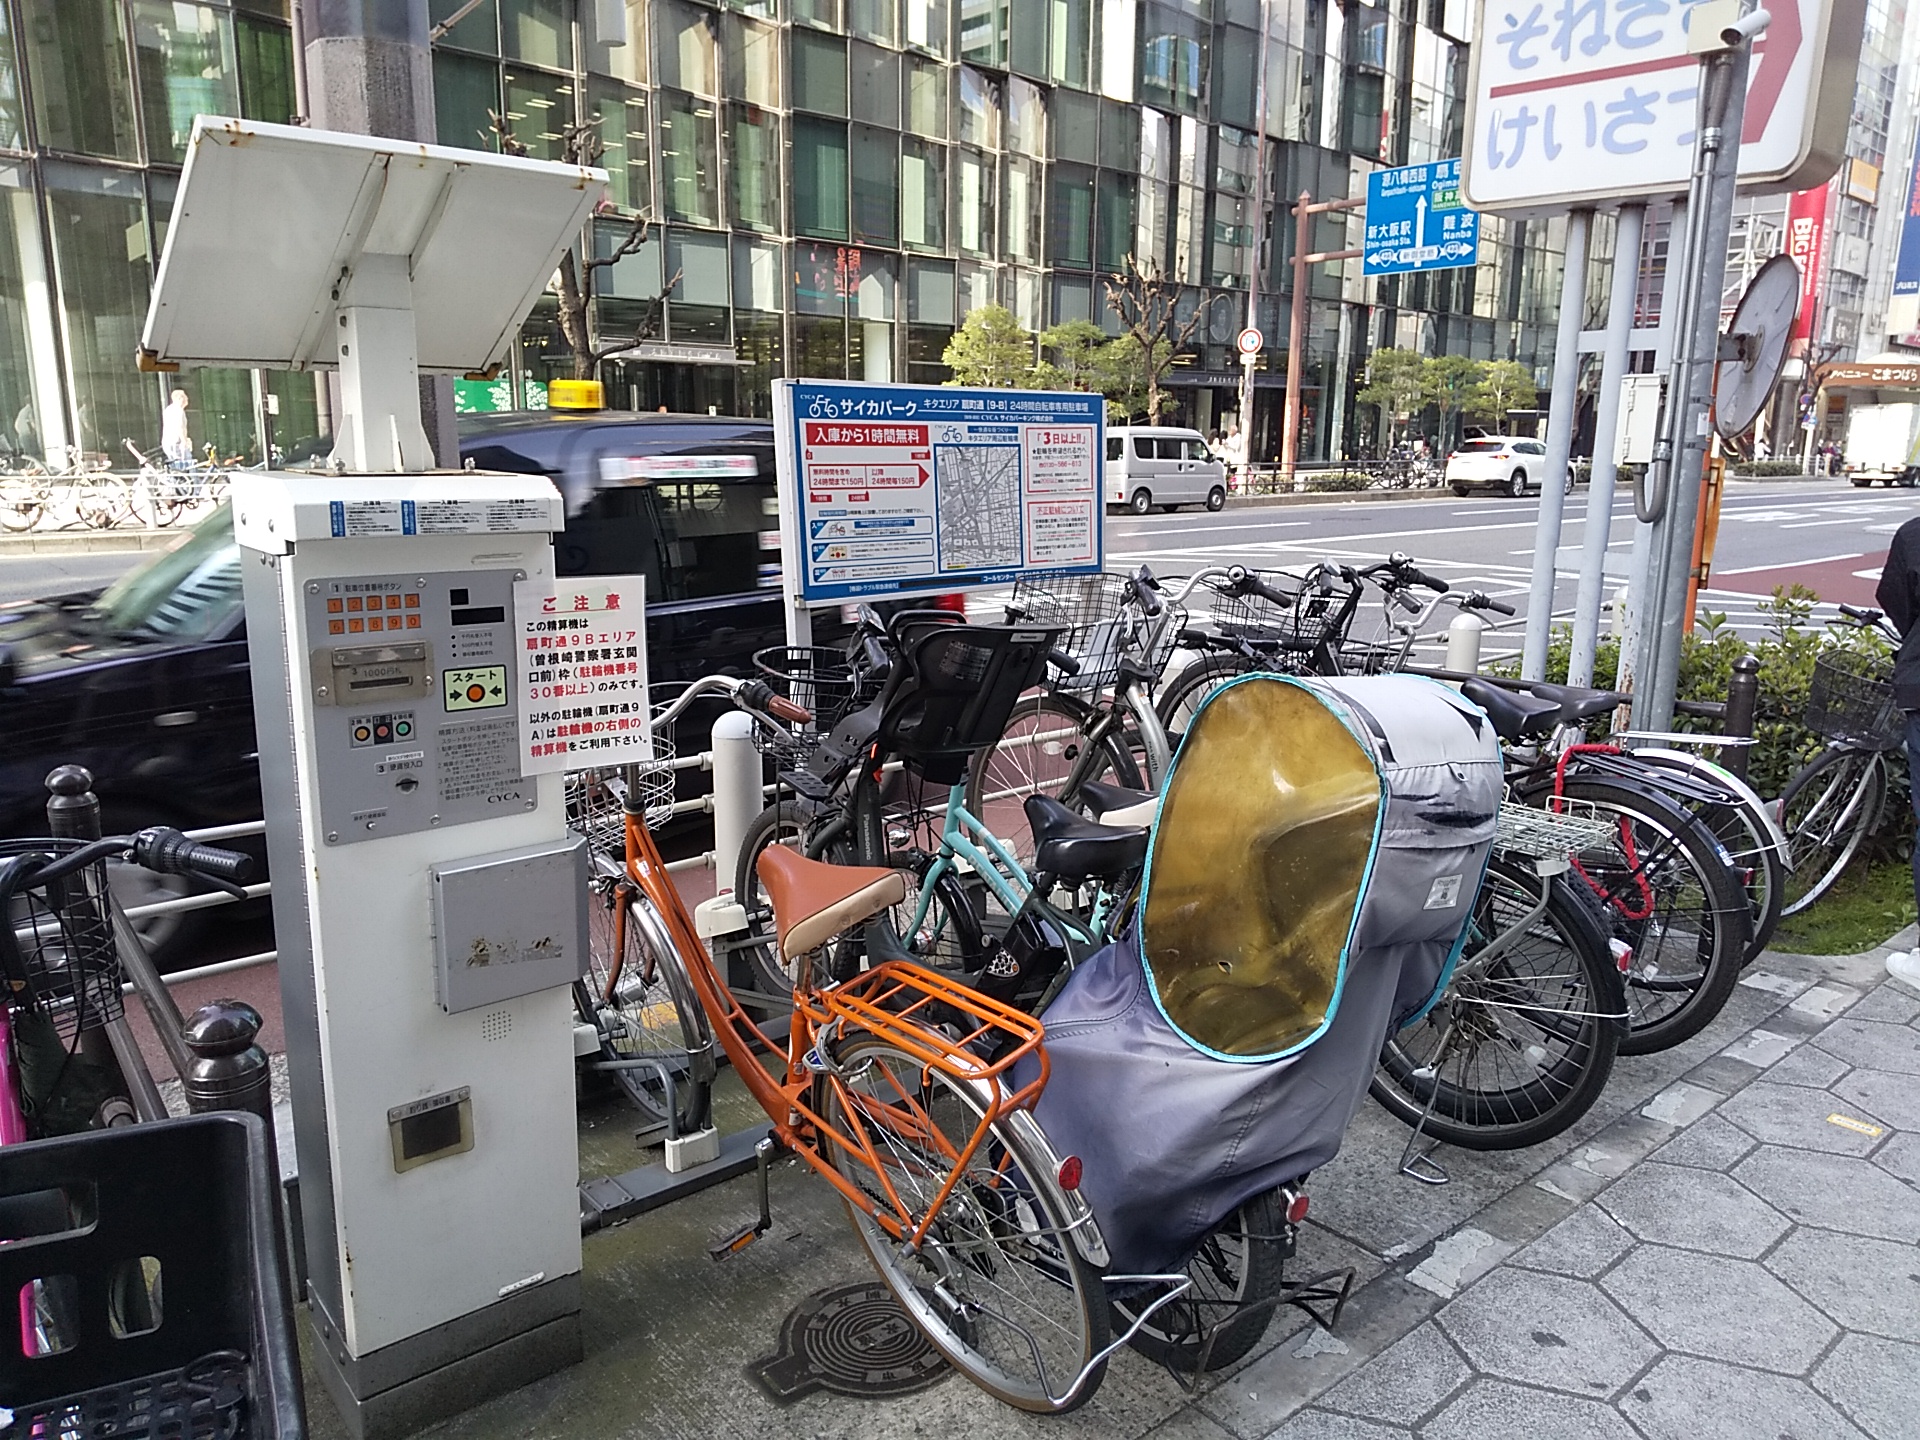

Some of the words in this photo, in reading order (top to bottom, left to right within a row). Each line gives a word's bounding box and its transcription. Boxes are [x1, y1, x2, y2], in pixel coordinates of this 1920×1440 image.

[1443, 213, 1474, 231] 難波
[1368, 221, 1411, 239] 新大阪駅
[1443, 230, 1472, 240] Nanba
[1872, 368, 1918, 382] こまつばら
[840, 399, 917, 416] サイカパーク
[923, 398, 959, 409] キタエリア
[815, 427, 920, 444] 入庫から1時間無料
[813, 477, 864, 486] 24時間まで150円
[542, 593, 620, 611] ご注意
[526, 618, 589, 632] この精算機は
[526, 630, 637, 650] 扇町通9Bエリア
[452, 670, 497, 683] スタート
[531, 736, 647, 758] 精算機をご利用下さい。
[378, 765, 385, 773] 3
[487, 791, 521, 804] CYCA
[863, 813, 872, 861] Panasonic
